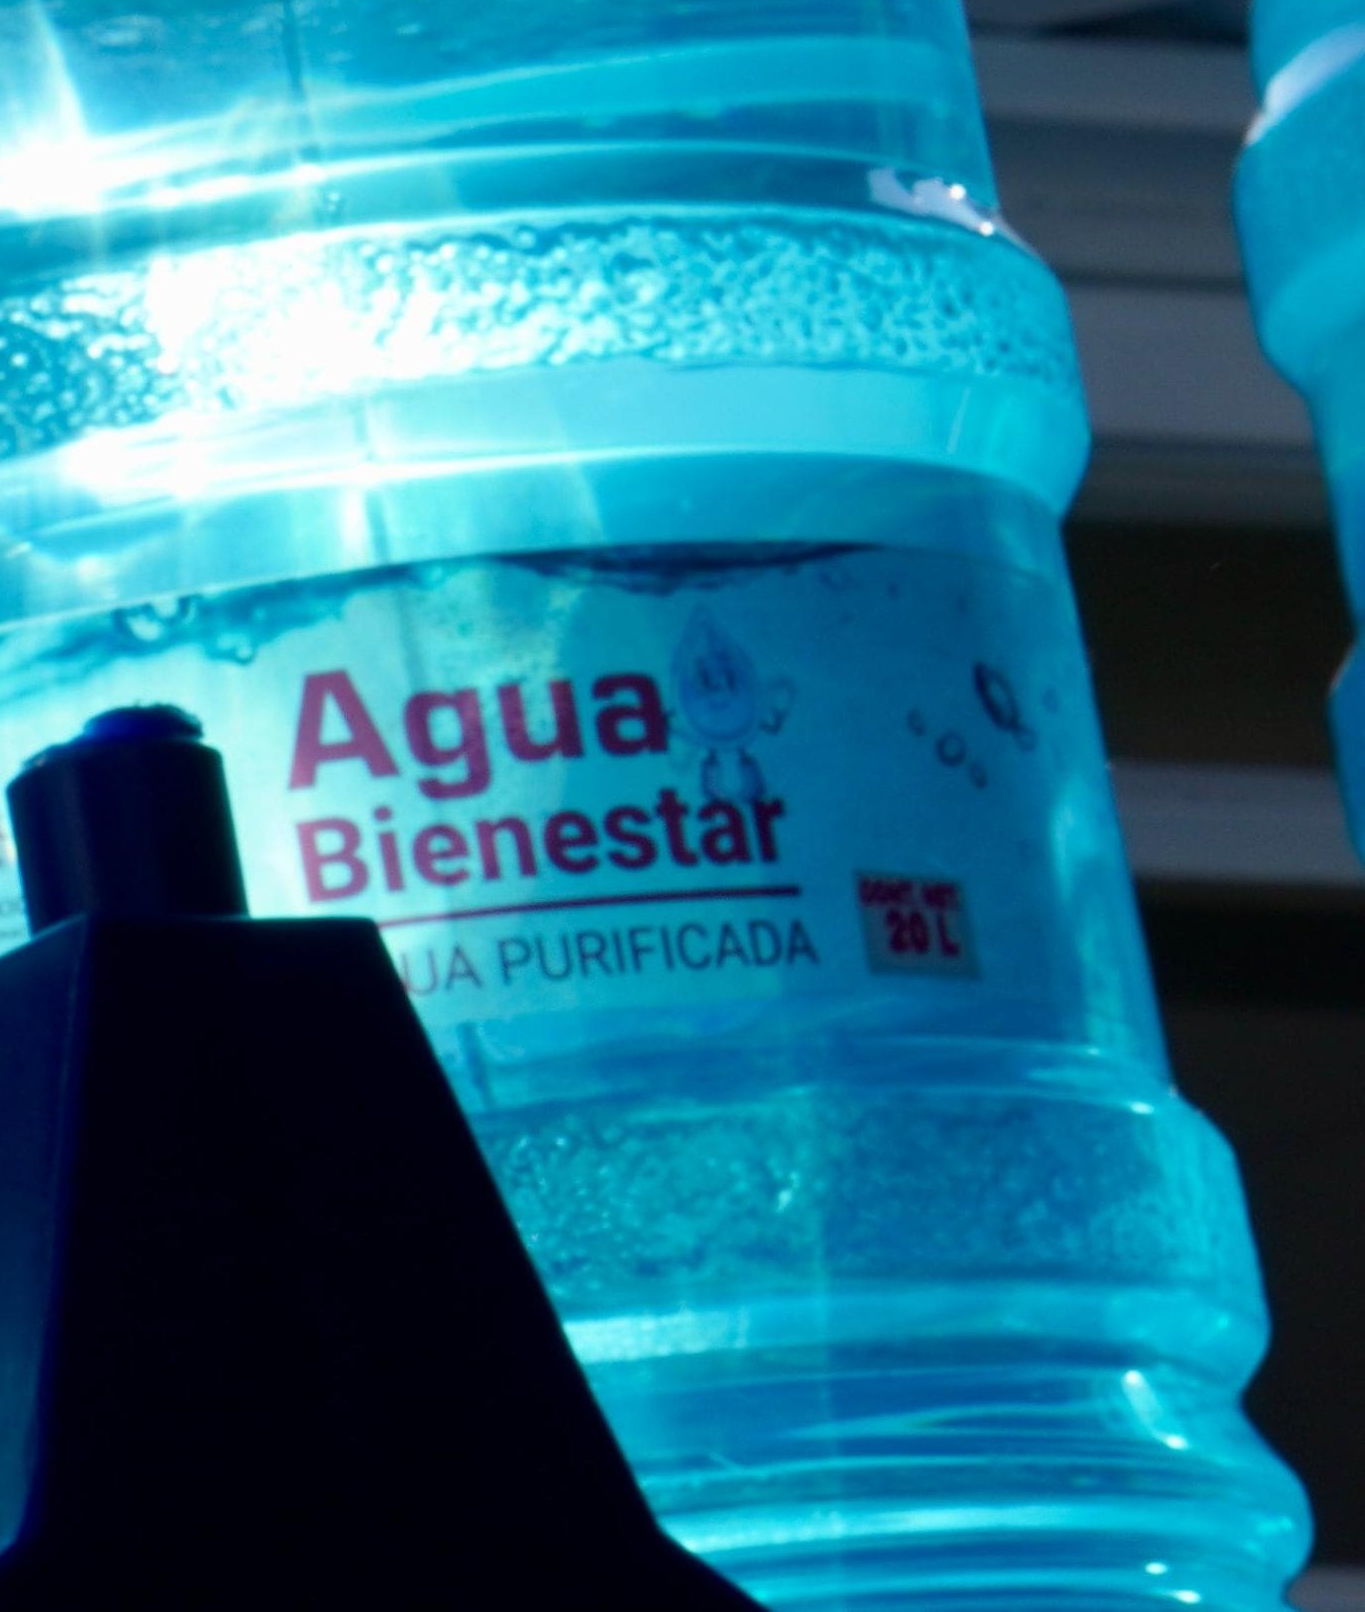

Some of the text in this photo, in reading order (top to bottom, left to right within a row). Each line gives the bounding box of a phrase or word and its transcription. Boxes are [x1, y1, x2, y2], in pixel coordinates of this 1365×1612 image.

[288, 668, 670, 801] Agua
[295, 787, 787, 904] Bienestar
[399, 918, 822, 997] UA PURIFICADA
[885, 909, 960, 959] 20 L
